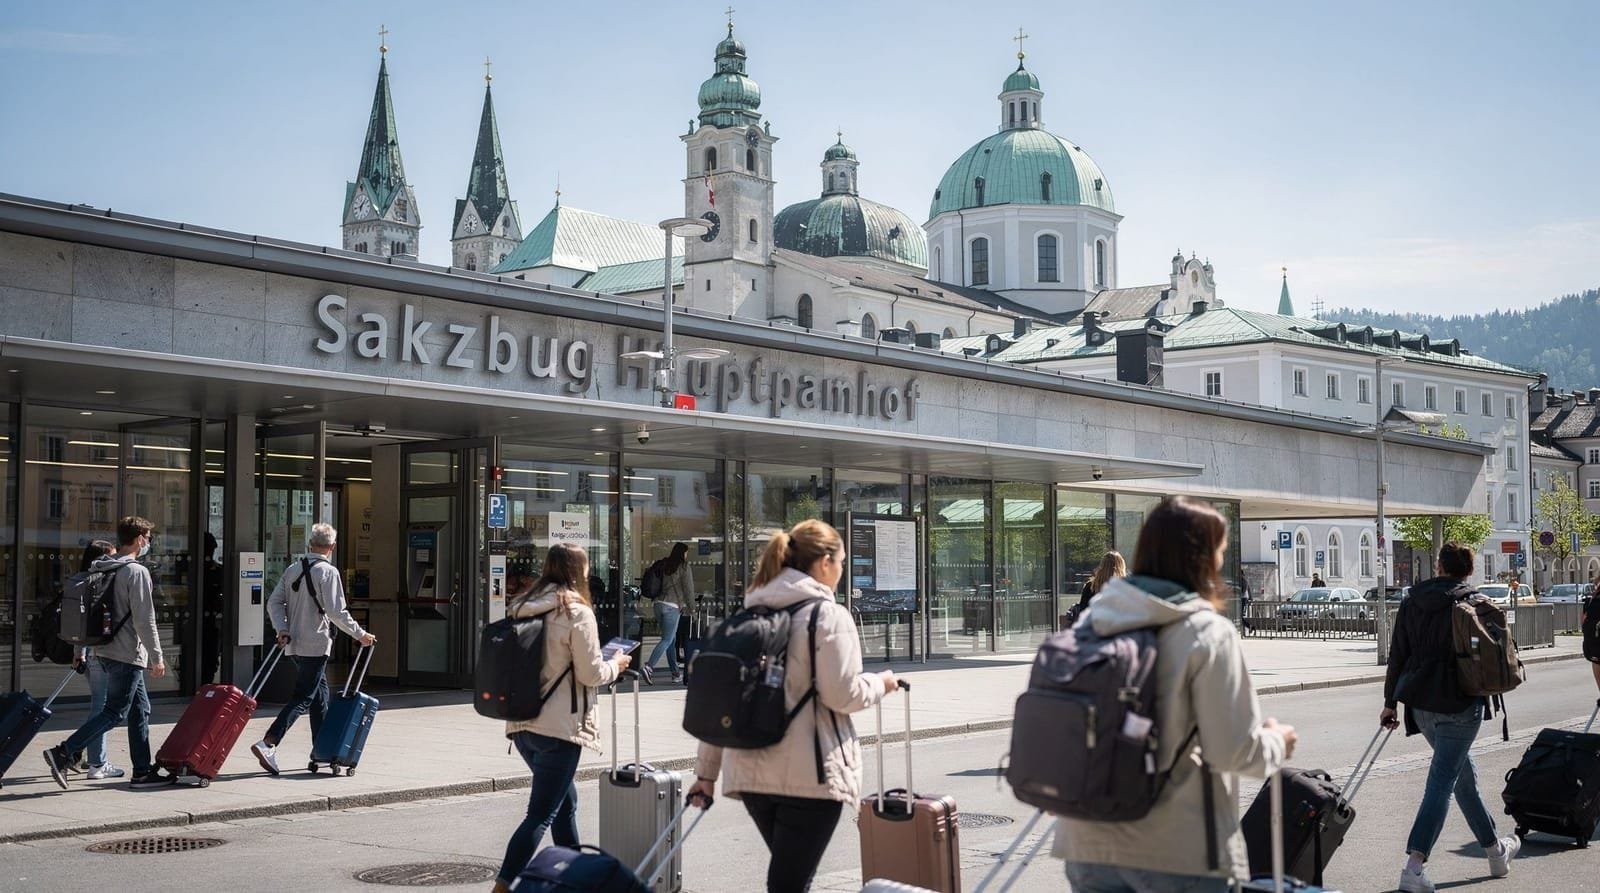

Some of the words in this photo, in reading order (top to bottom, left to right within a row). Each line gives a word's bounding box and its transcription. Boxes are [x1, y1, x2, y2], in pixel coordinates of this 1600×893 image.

[315, 294, 593, 393] Sakzbug
[617, 334, 921, 421] Huptpamhof
[490, 496, 501, 514] P
[1281, 533, 1290, 545] P
